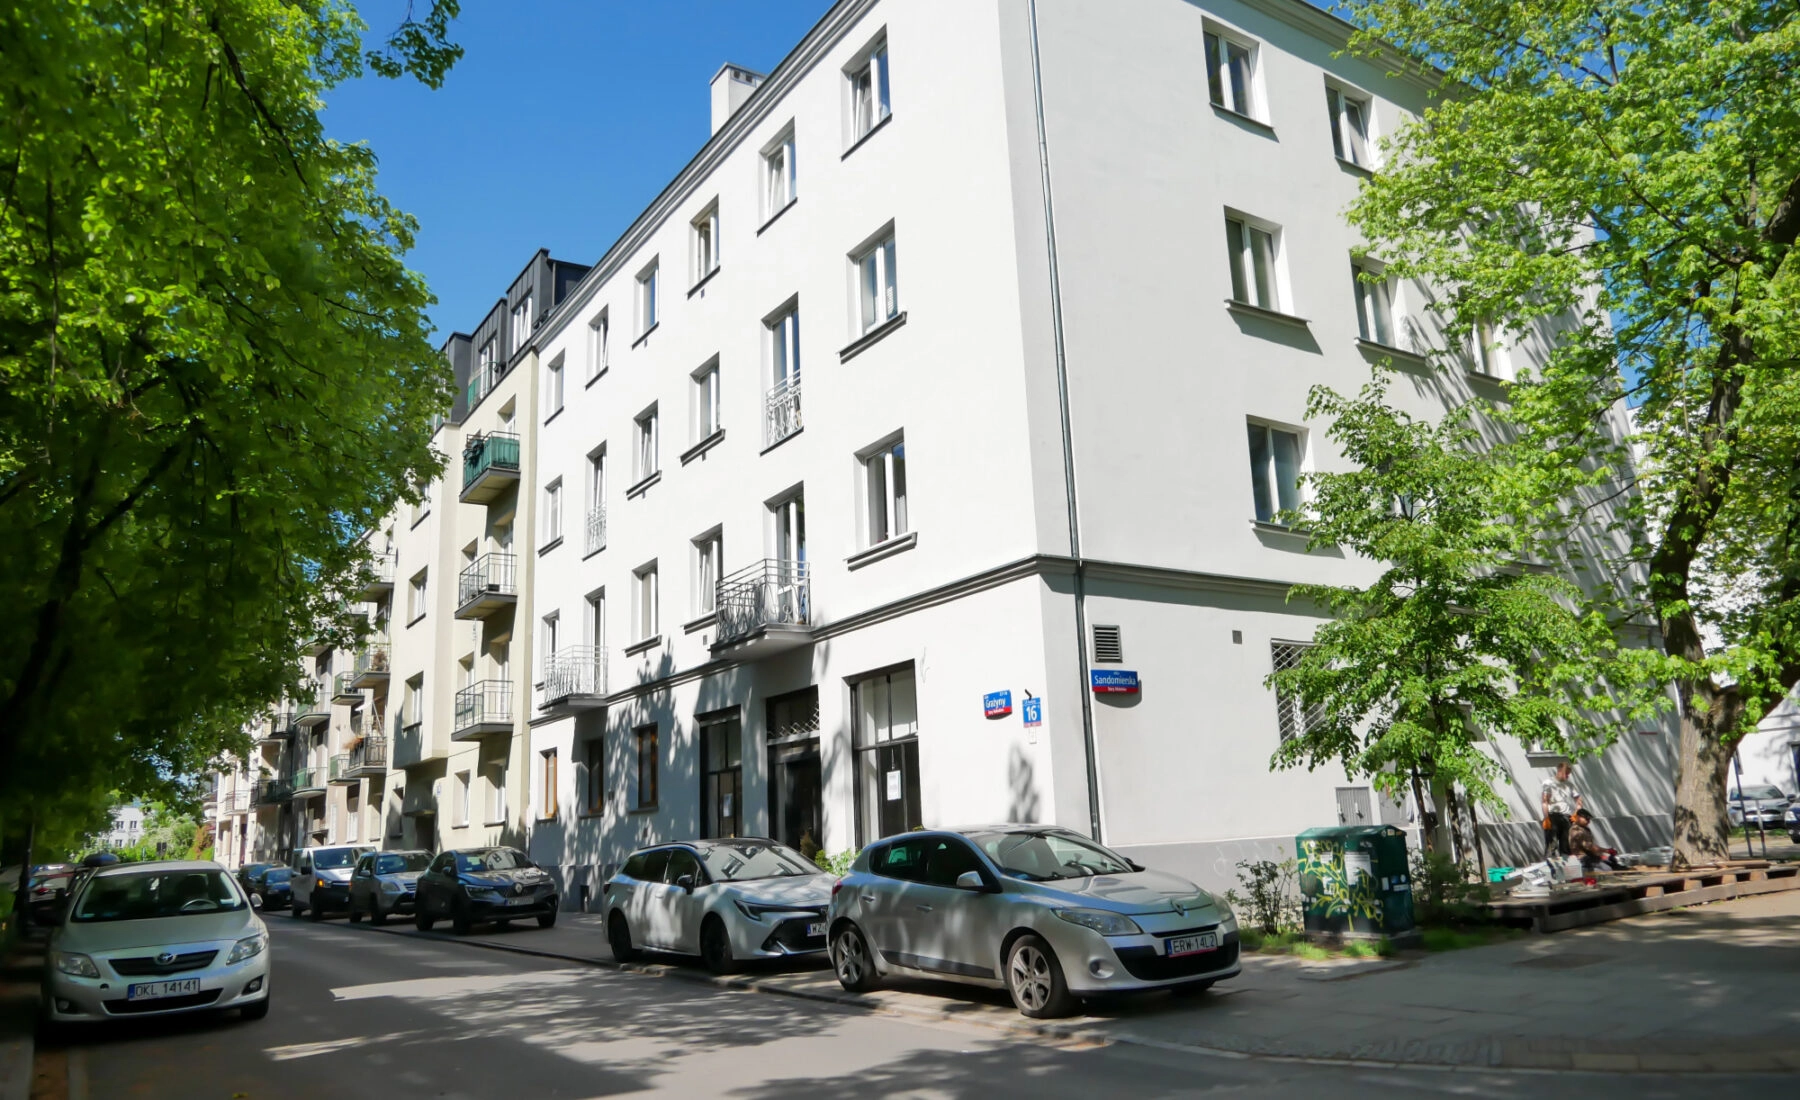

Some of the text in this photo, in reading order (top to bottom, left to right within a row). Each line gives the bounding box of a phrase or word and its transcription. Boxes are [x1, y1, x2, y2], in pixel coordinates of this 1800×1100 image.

[1094, 675, 1137, 685] Sandomierska
[1026, 705, 1038, 721] 16
[1173, 939, 1192, 952] ERW
[163, 980, 197, 994] 14141
